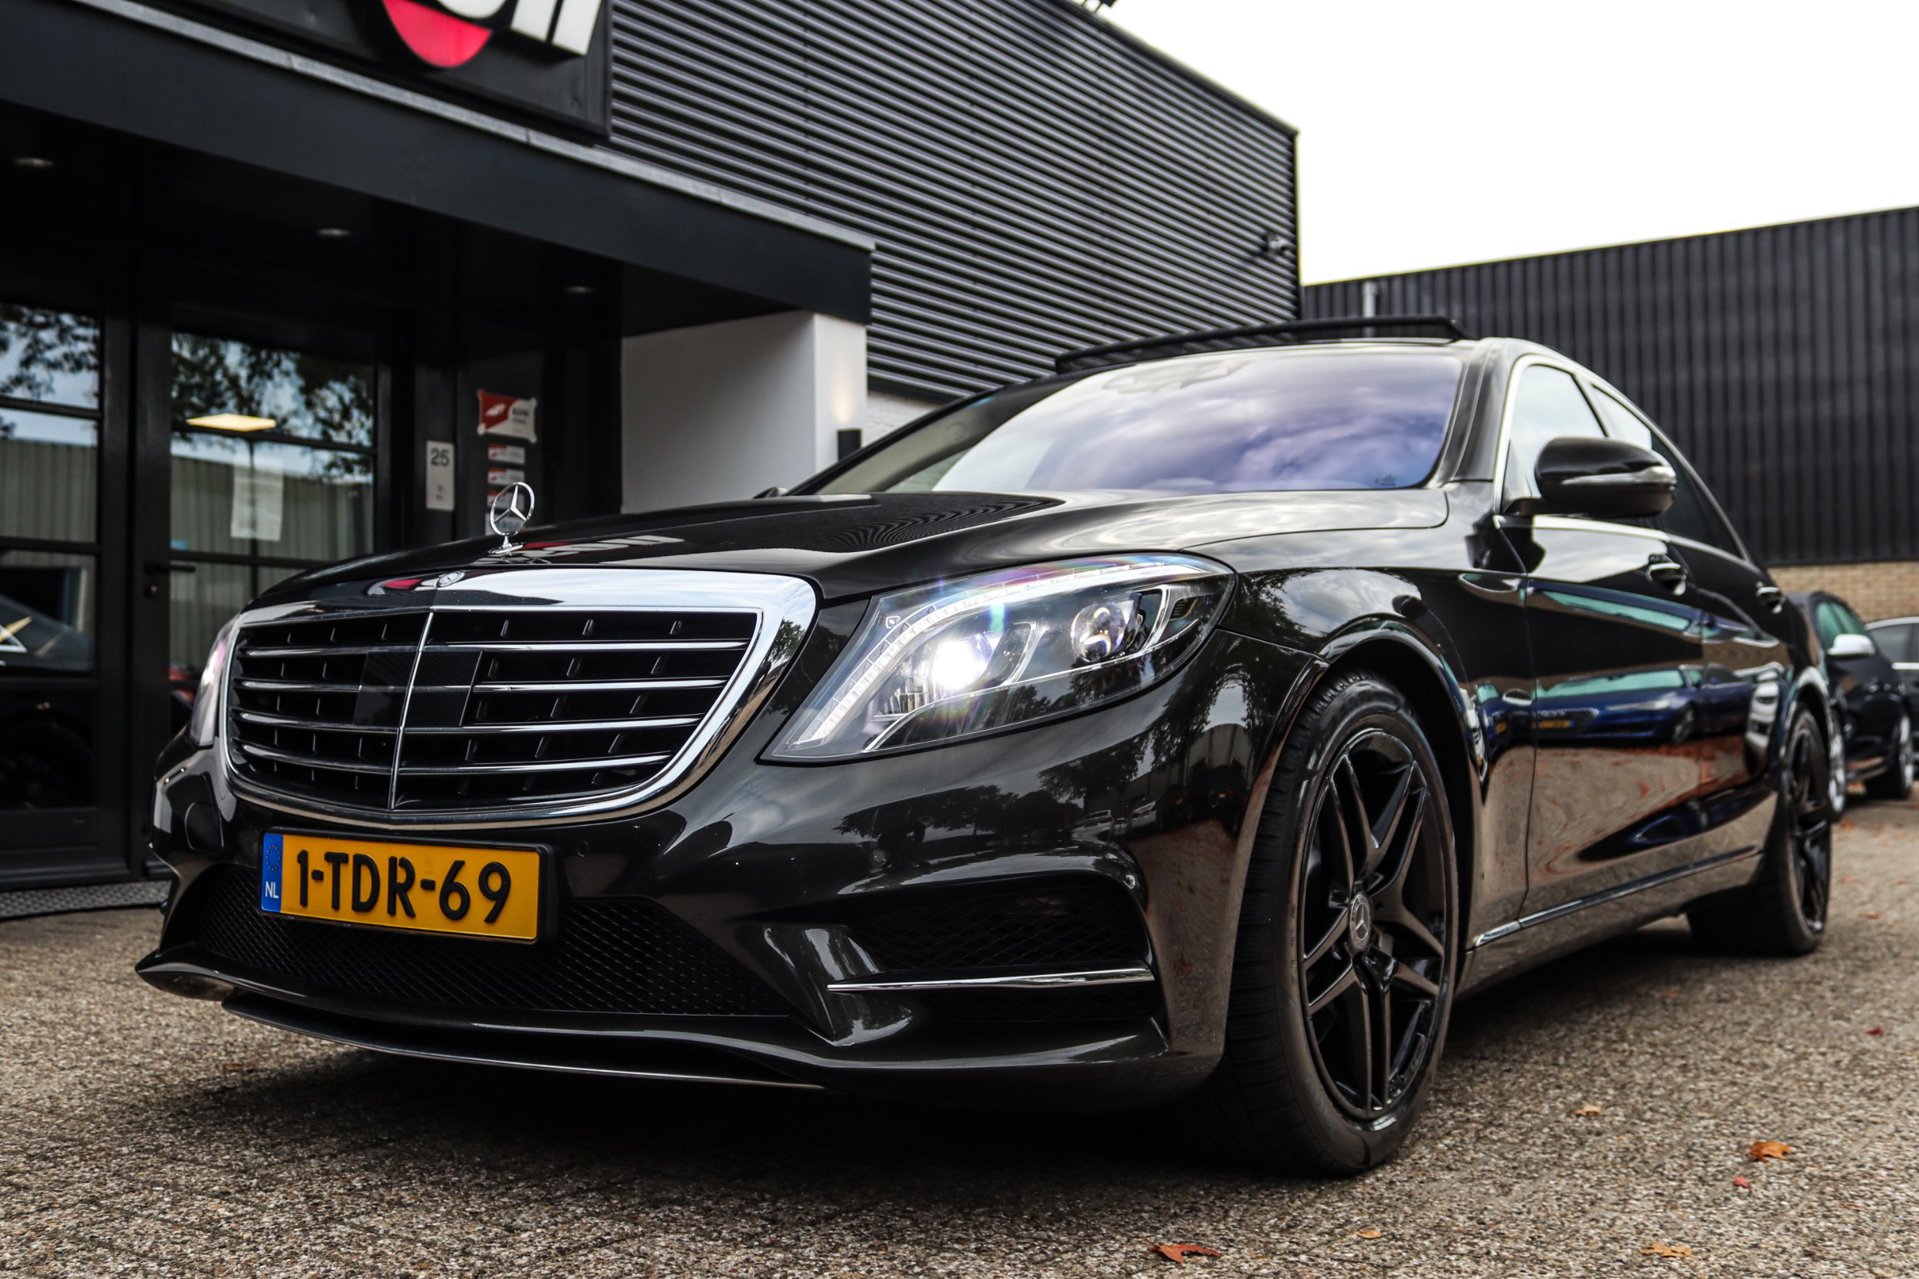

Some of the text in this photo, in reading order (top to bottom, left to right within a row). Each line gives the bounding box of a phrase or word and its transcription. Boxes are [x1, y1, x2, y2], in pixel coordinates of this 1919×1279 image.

[430, 447, 449, 467] 25
[265, 881, 279, 899] NL
[297, 849, 511, 924] 1-TDR-69
